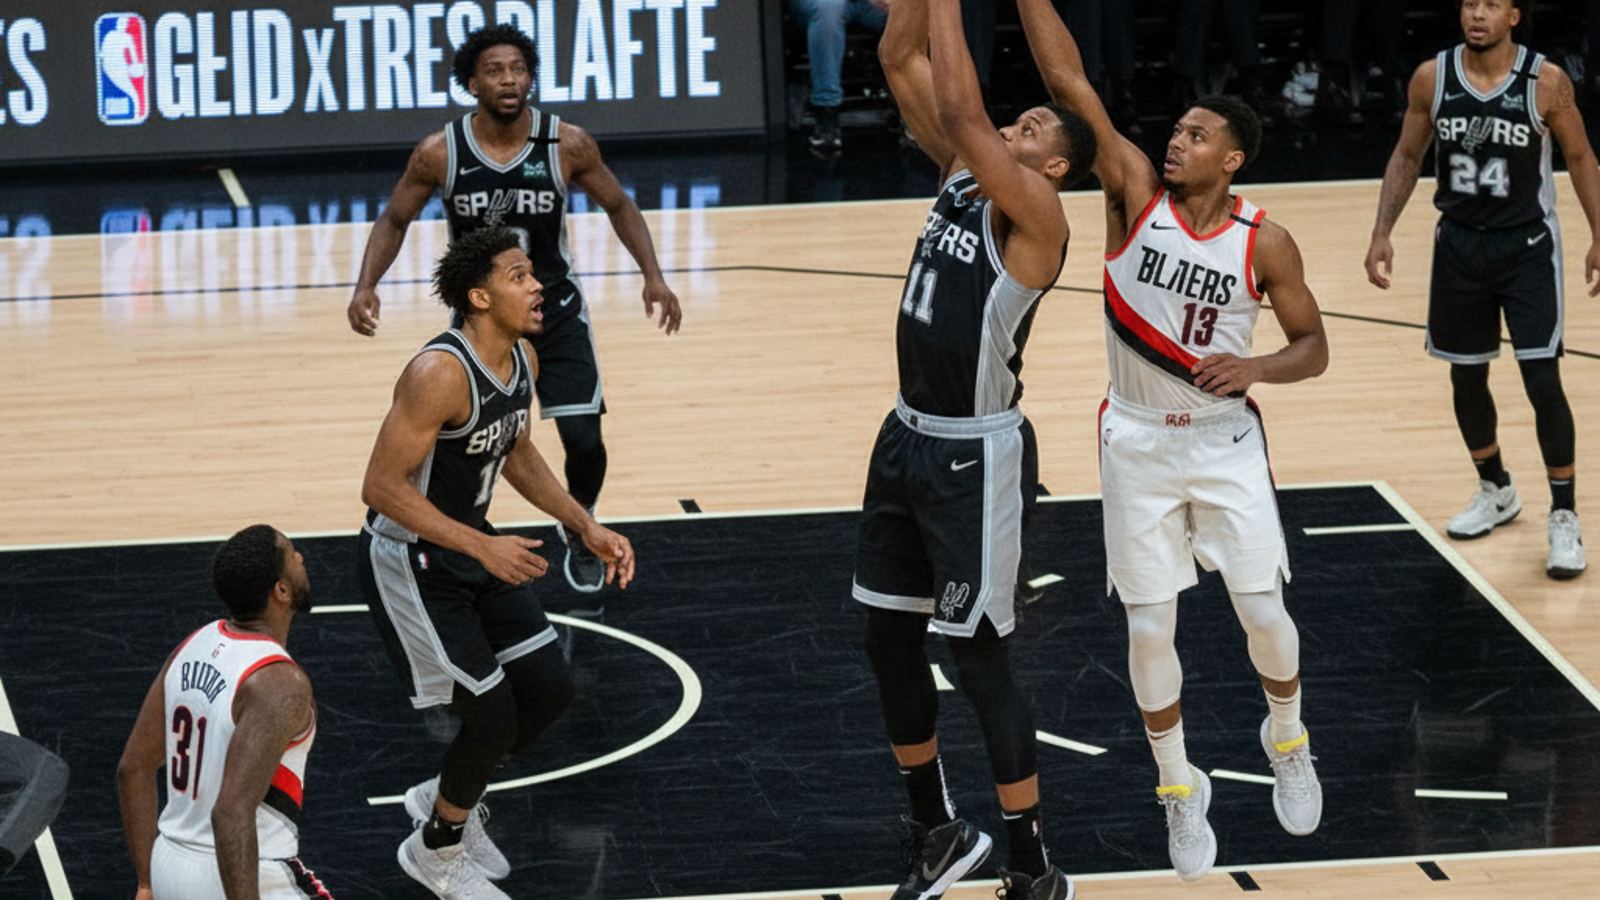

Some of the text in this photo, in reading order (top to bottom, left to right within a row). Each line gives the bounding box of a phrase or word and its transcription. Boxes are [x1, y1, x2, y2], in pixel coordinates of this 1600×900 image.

[0, 18, 48, 125] S
[1450, 152, 1509, 197] 24
[902, 262, 938, 326] 11
[1181, 303, 1218, 347] 13
[465, 409, 528, 456] SPUR
[474, 456, 506, 507] 1
[172, 705, 207, 801] 31
